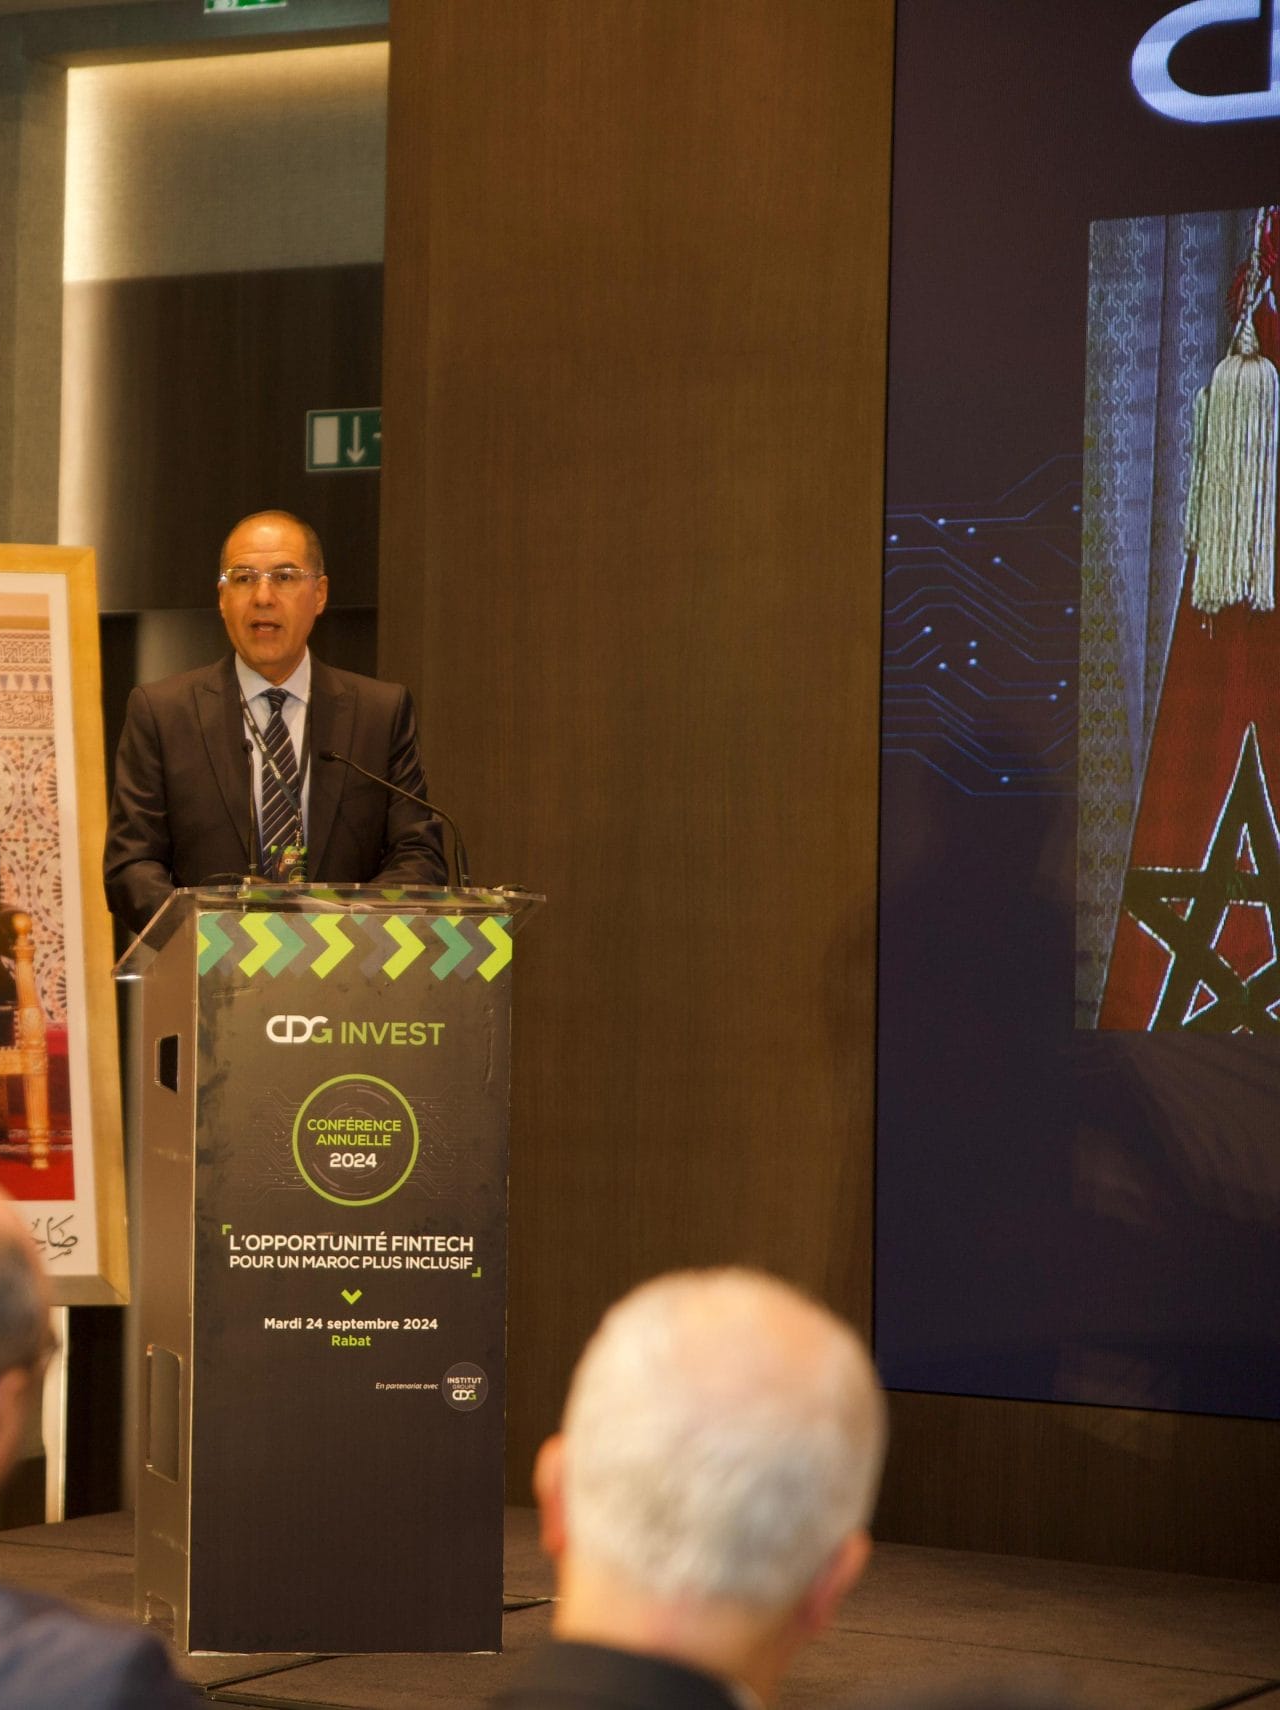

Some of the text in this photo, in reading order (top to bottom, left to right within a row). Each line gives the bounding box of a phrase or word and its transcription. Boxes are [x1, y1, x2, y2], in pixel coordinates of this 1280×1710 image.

[266, 1014, 445, 1045] CDG INVEST
[307, 1117, 402, 1131] CONFÉRENCE
[316, 1134, 392, 1146] ANNUELLE
[330, 1153, 377, 1168] 2024
[230, 1231, 474, 1252] L'OPPORTUNITÉ FINTECH
[230, 1255, 473, 1270] POUR UN MAROC PLUS INCLUSIF
[264, 1317, 438, 1333] Mardi 24 septembre 2024
[331, 1335, 371, 1347] Rabat
[375, 1382, 385, 1390] En
[386, 1382, 422, 1391] partenariat
[452, 1389, 477, 1401] CDG
